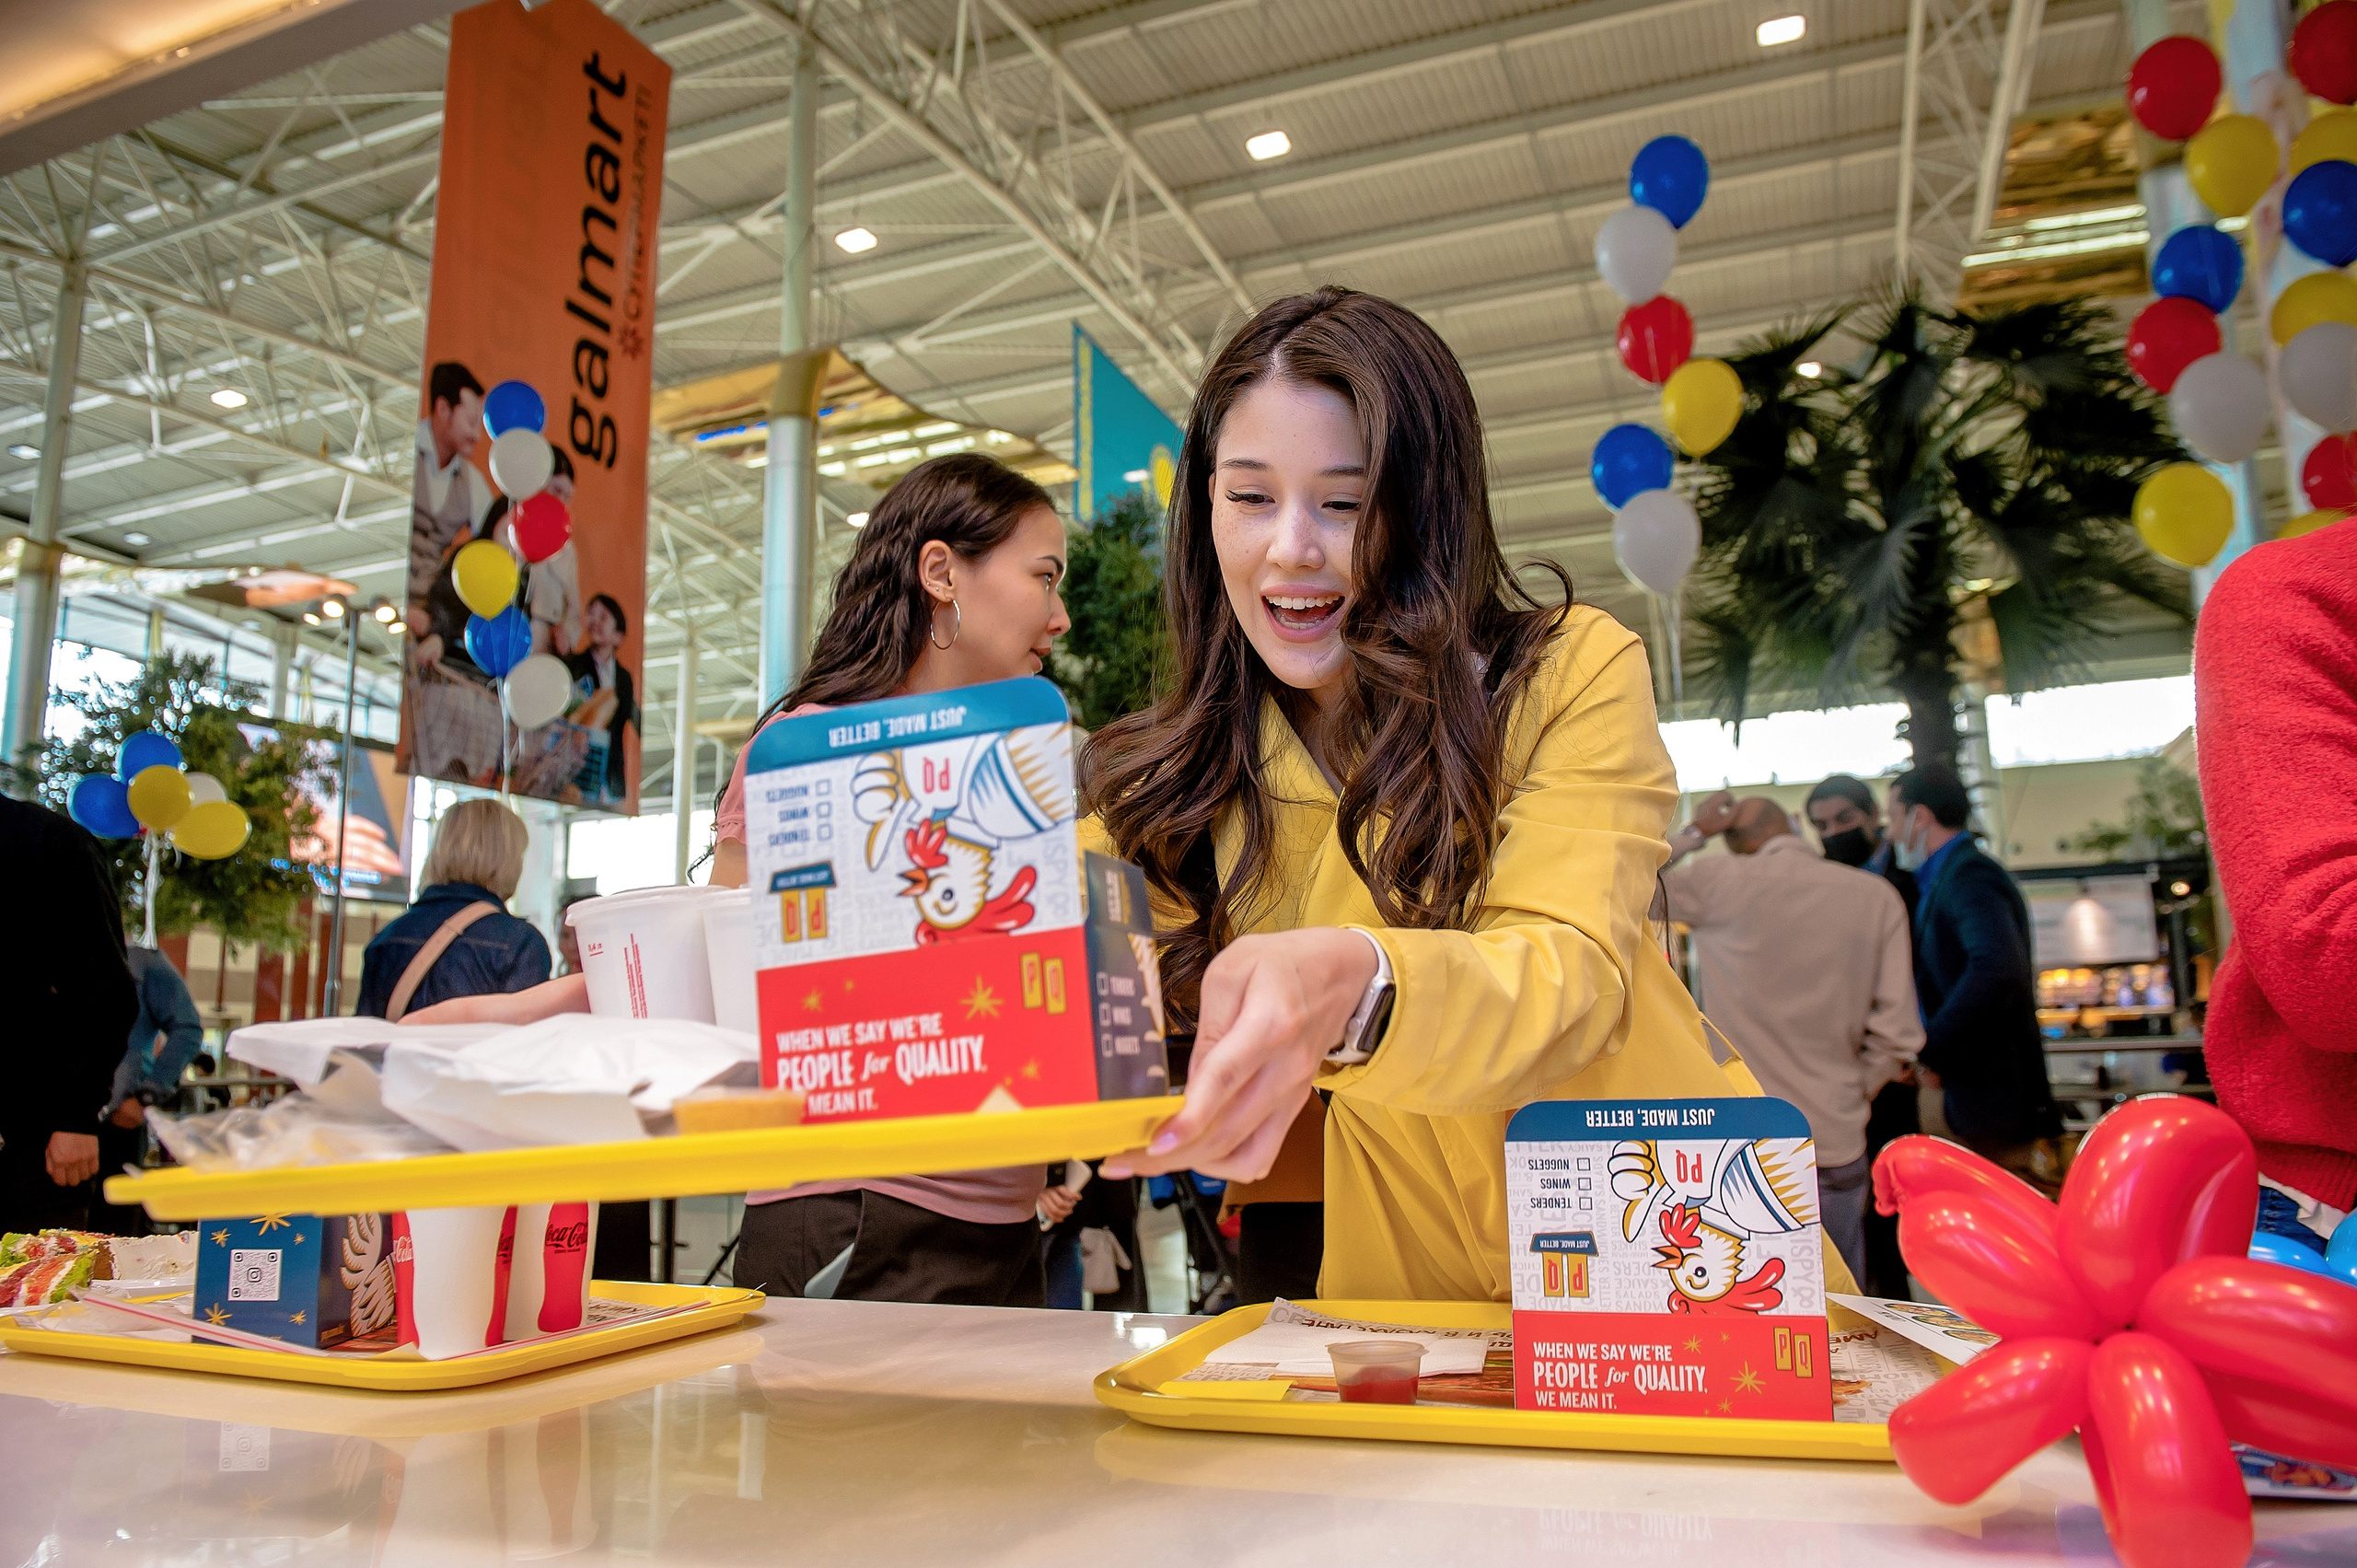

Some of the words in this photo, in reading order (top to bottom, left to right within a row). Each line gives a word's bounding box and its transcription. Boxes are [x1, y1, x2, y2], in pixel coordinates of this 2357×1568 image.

[566, 51, 626, 470] galmart
[930, 705, 967, 730] JUST
[829, 721, 881, 748] BETTER
[923, 756, 950, 795] PQ
[776, 1028, 824, 1054] WHEN
[826, 1023, 853, 1049] WE
[854, 1018, 887, 1045] SAY
[777, 1050, 854, 1092] PEOPLE
[860, 1051, 891, 1082] for
[807, 1089, 856, 1117] MEAN
[1585, 1109, 1634, 1127] BETTER
[1681, 1109, 1716, 1126] JUST
[1527, 1158, 1570, 1171] NUGGETS
[1676, 1150, 1703, 1184] PQ
[1539, 1178, 1572, 1191] WINGS
[1530, 1197, 1572, 1210] TENDERS
[1539, 1239, 1559, 1249] BETTER
[1576, 1240, 1590, 1249] JUST
[1548, 1260, 1585, 1293] PQ
[1533, 1342, 1573, 1359] WHEN
[1576, 1343, 1597, 1360] WE
[1601, 1343, 1627, 1361] SAY
[1629, 1344, 1673, 1362] WE'RE
[1778, 1332, 1809, 1369] PQ
[1534, 1361, 1598, 1389] PEOPLE
[1605, 1366, 1630, 1388] for
[1535, 1390, 1557, 1408] WE
[1560, 1391, 1599, 1409] MEAN
[1601, 1393, 1617, 1410] IT.
